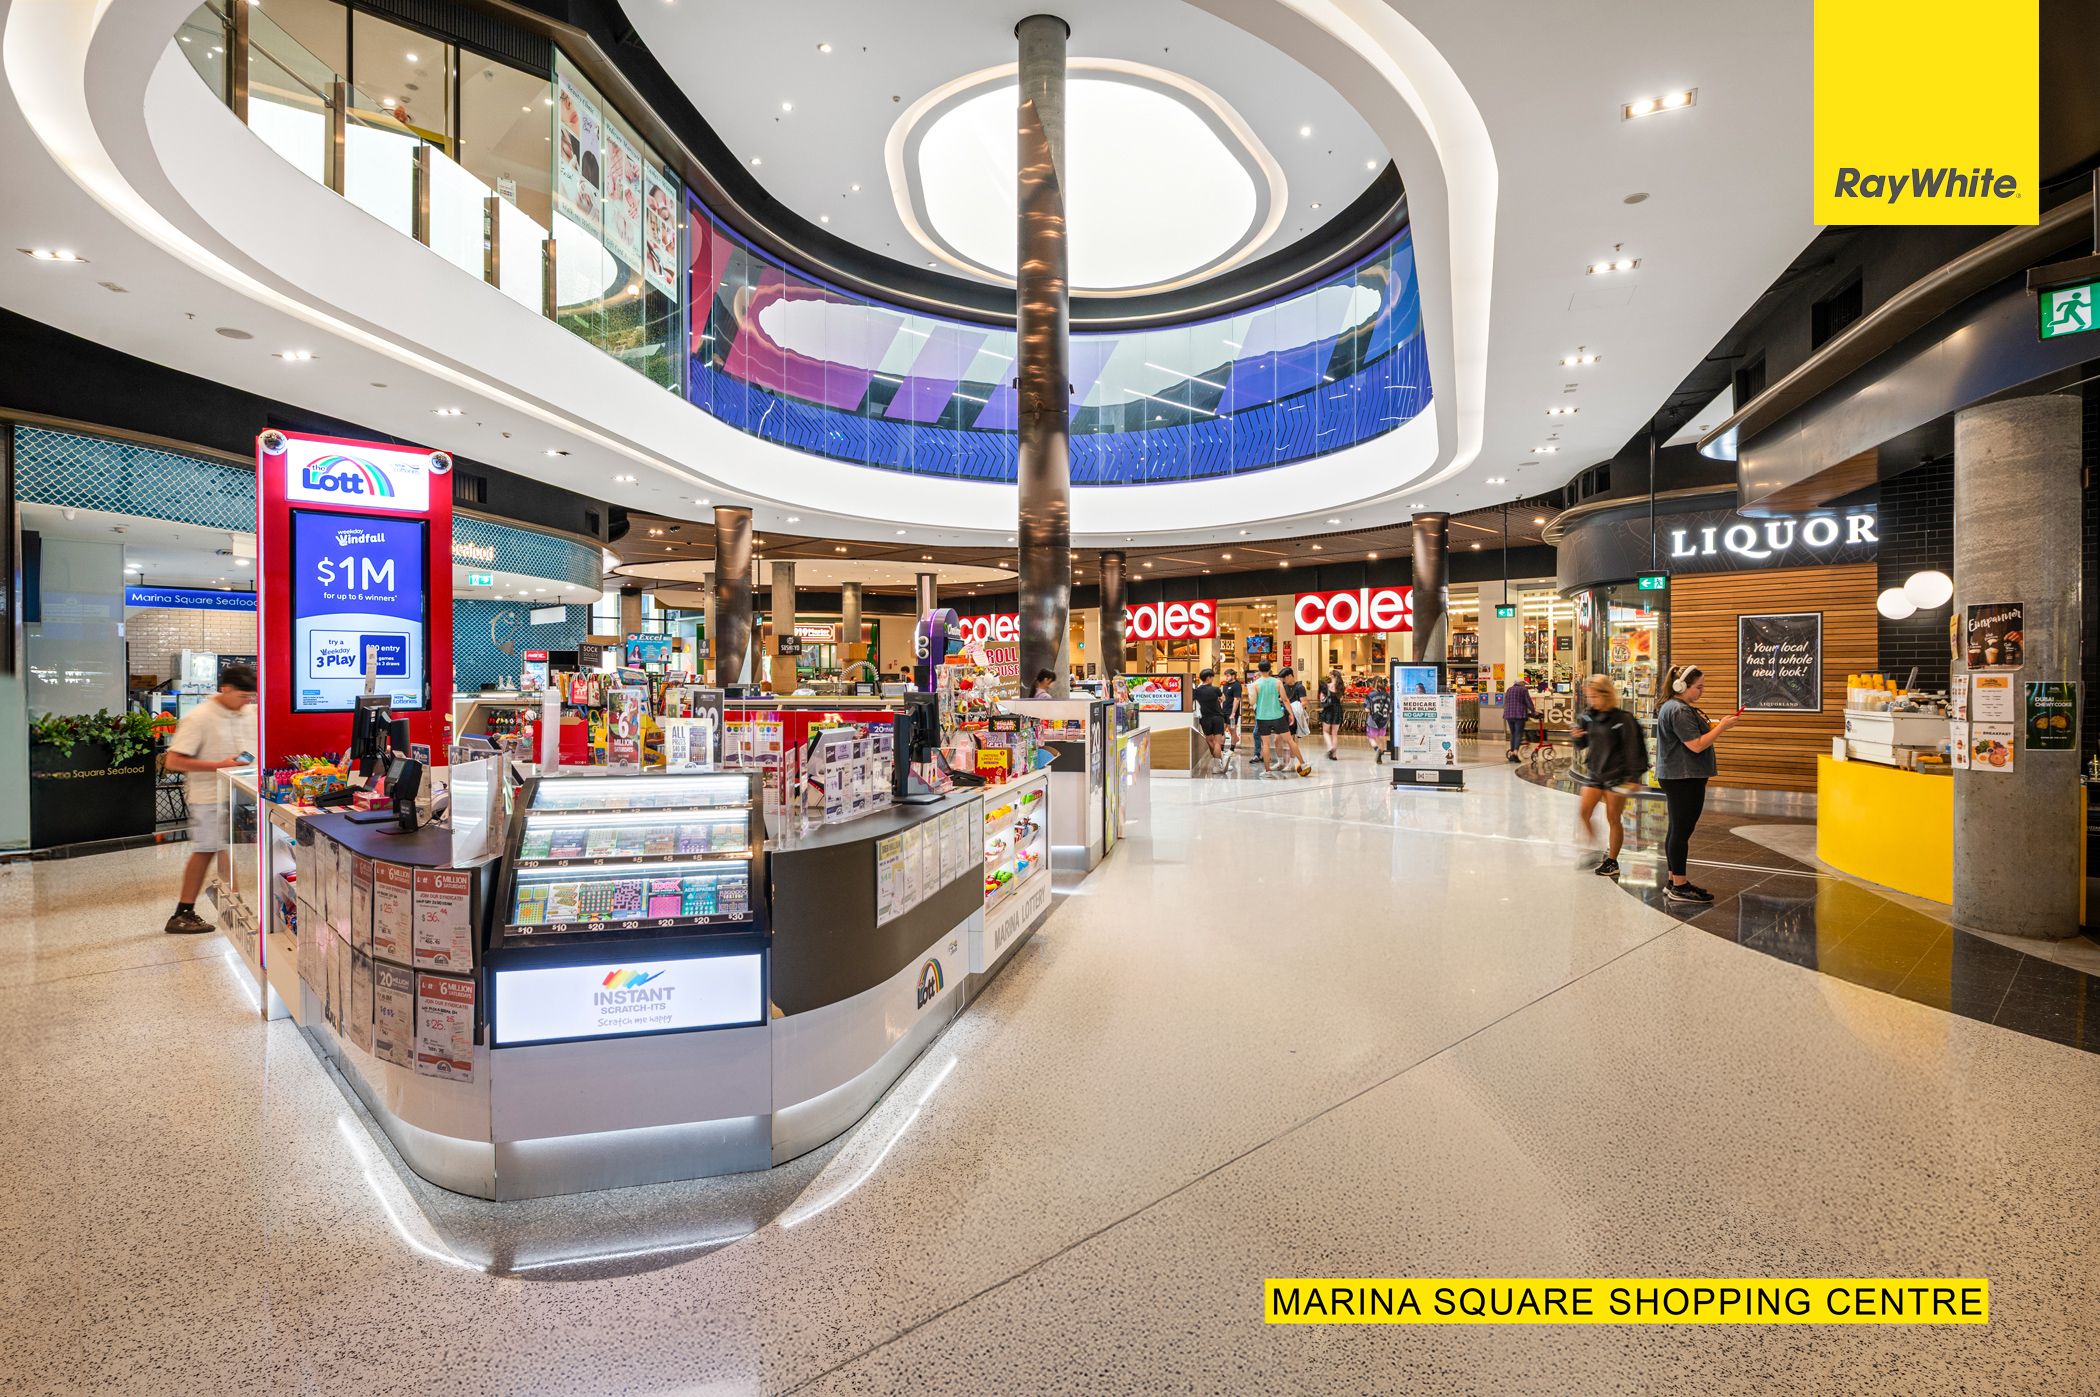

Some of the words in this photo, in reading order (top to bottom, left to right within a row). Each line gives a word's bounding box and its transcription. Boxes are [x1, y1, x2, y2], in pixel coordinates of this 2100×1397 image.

[312, 464, 326, 472] the
[302, 467, 364, 494] Lott
[335, 533, 385, 547] Windfall
[1671, 514, 1879, 559] LIQUOR
[317, 556, 395, 592] $1M
[132, 593, 172, 602] Marina
[175, 594, 213, 605] Square
[320, 647, 351, 656] Weekday
[1754, 642, 1780, 652] Your
[1780, 641, 1809, 652] local
[316, 656, 325, 668] 3
[326, 655, 357, 668] Play
[986, 647, 1018, 664] ROLL
[1746, 654, 1766, 665] has
[1768, 657, 1776, 665] a
[1779, 654, 1814, 665] whole
[1752, 668, 1776, 677] new
[1779, 667, 1808, 677] look!
[672, 726, 686, 738] ALL
[73, 769, 105, 779] Square
[106, 765, 145, 775] Seafood
[442, 875, 467, 884] MILLION
[518, 926, 533, 935] $10
[552, 923, 567, 932] $10
[588, 922, 605, 931] $20
[622, 920, 639, 929] $20
[658, 918, 674, 927] $20
[694, 916, 710, 924] $20
[728, 912, 744, 920] $30
[995, 910, 1020, 952] MARINA
[1021, 885, 1046, 922] LOTTERY
[447, 983, 473, 993] MILLION
[917, 976, 935, 1010] Lott
[593, 986, 676, 1006] INSTANT
[601, 1002, 666, 1014] SCRATCH-ITS
[597, 1017, 632, 1027] Scratch
[634, 1016, 648, 1024] me
[649, 1014, 673, 1024] happy
